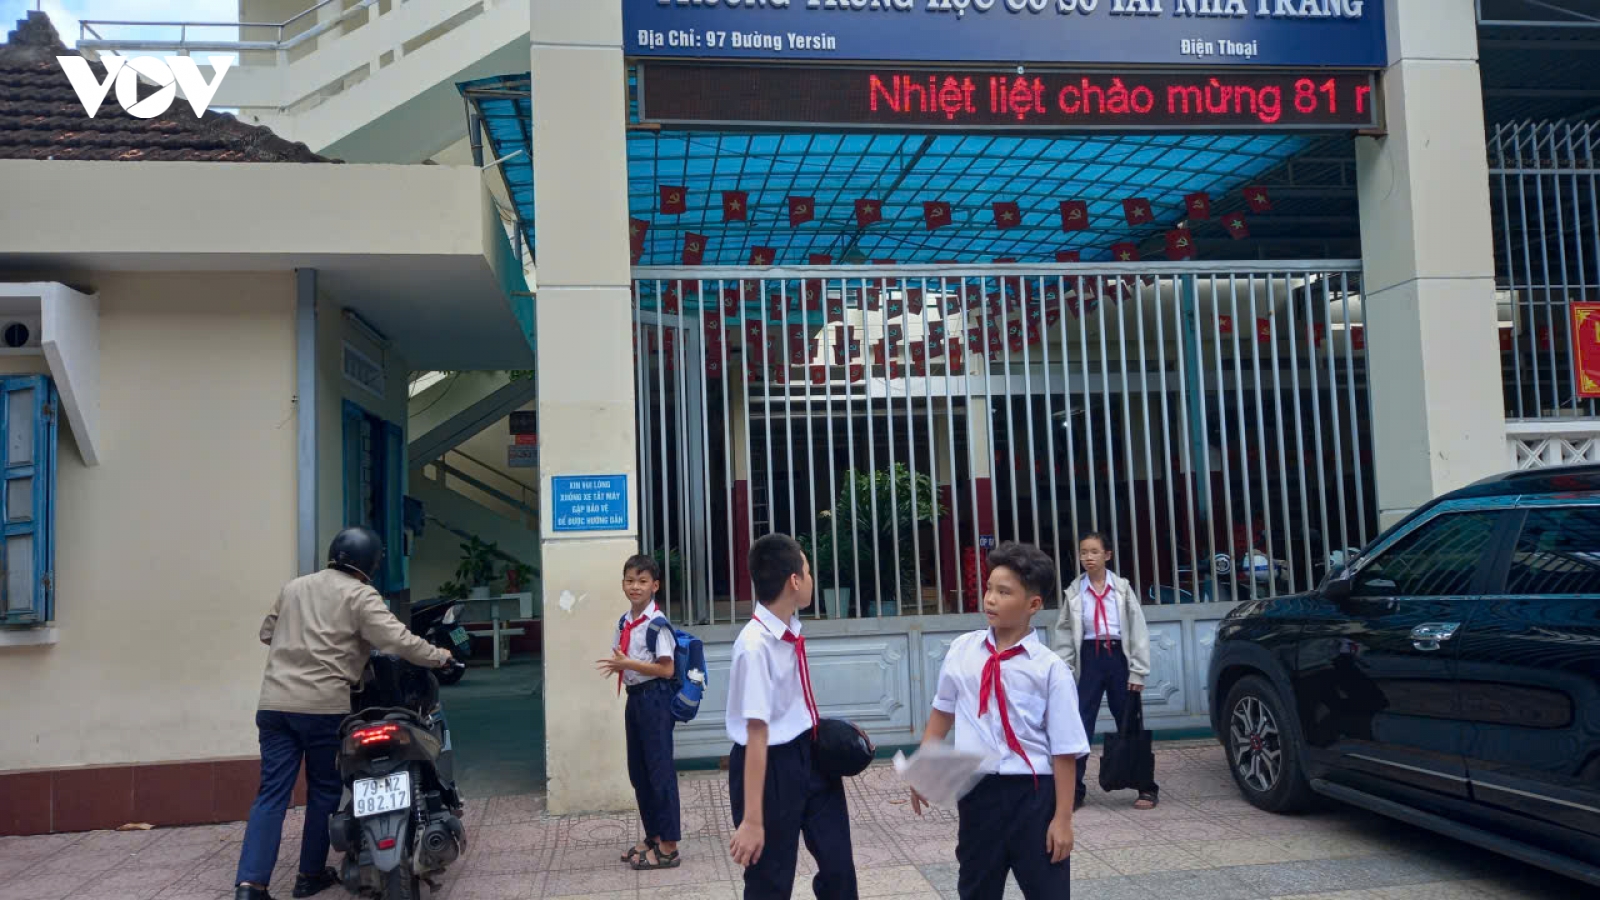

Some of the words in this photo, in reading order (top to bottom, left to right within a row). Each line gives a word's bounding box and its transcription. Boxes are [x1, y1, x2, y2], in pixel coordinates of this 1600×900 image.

[638, 30, 664, 49] Địa
[669, 28, 700, 47] Chỉ:
[706, 31, 726, 47] 97
[731, 31, 782, 51] Đường
[787, 33, 836, 50] Yersin
[1181, 39, 1213, 58] Điện
[1217, 39, 1257, 59] Thoại
[869, 74, 976, 120] Nhiệt
[990, 76, 1046, 120] liệt
[1058, 77, 1154, 114] chào
[1167, 78, 1281, 123] mừng
[1294, 78, 1337, 114] 81
[583, 493, 592, 501] XE
[358, 791, 405, 814] 982.17
